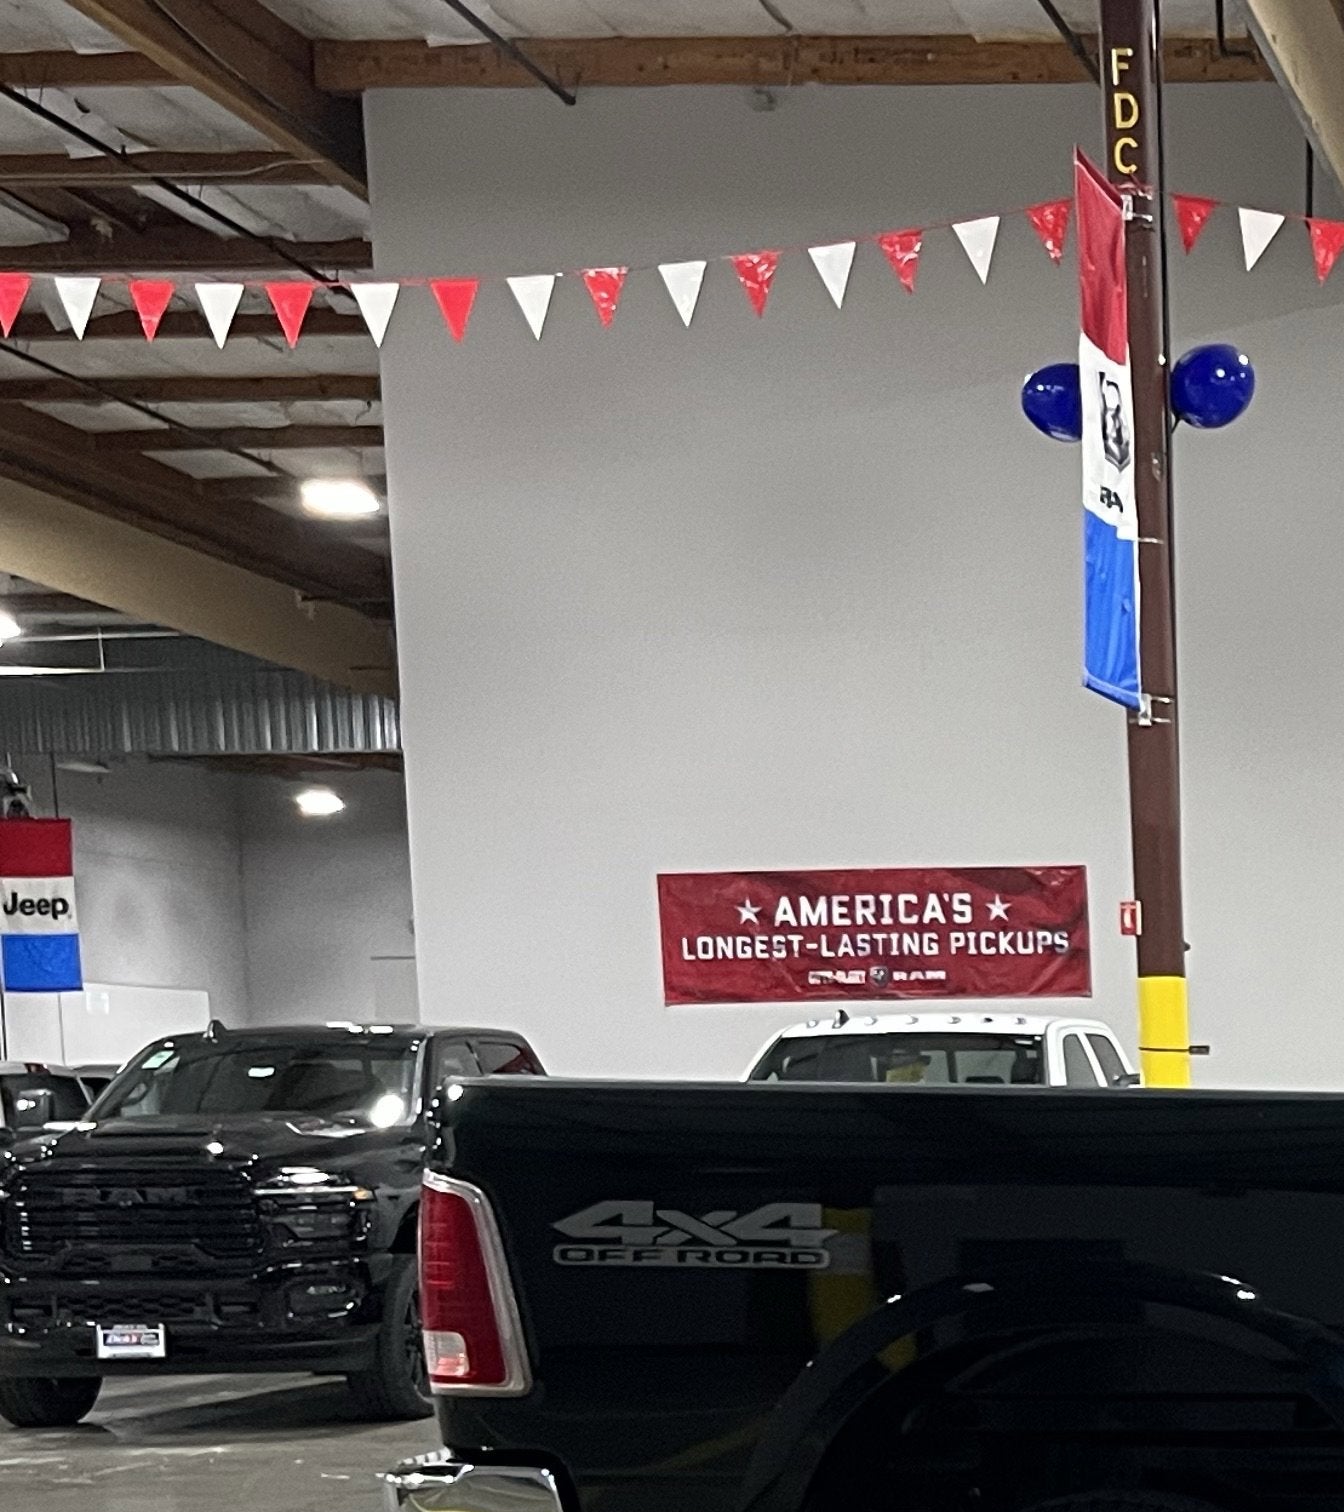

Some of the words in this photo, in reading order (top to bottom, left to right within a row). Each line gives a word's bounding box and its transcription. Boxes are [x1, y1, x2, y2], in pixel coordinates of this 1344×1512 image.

[3, 891, 70, 920] Jeep
[773, 892, 974, 928] AMERICA'S
[681, 931, 940, 962] LONGEST-LASTING
[949, 929, 1070, 956] PICKUPS
[892, 970, 947, 981] RAM
[557, 1247, 662, 1265] OFF
[675, 1249, 828, 1266] ROAD
